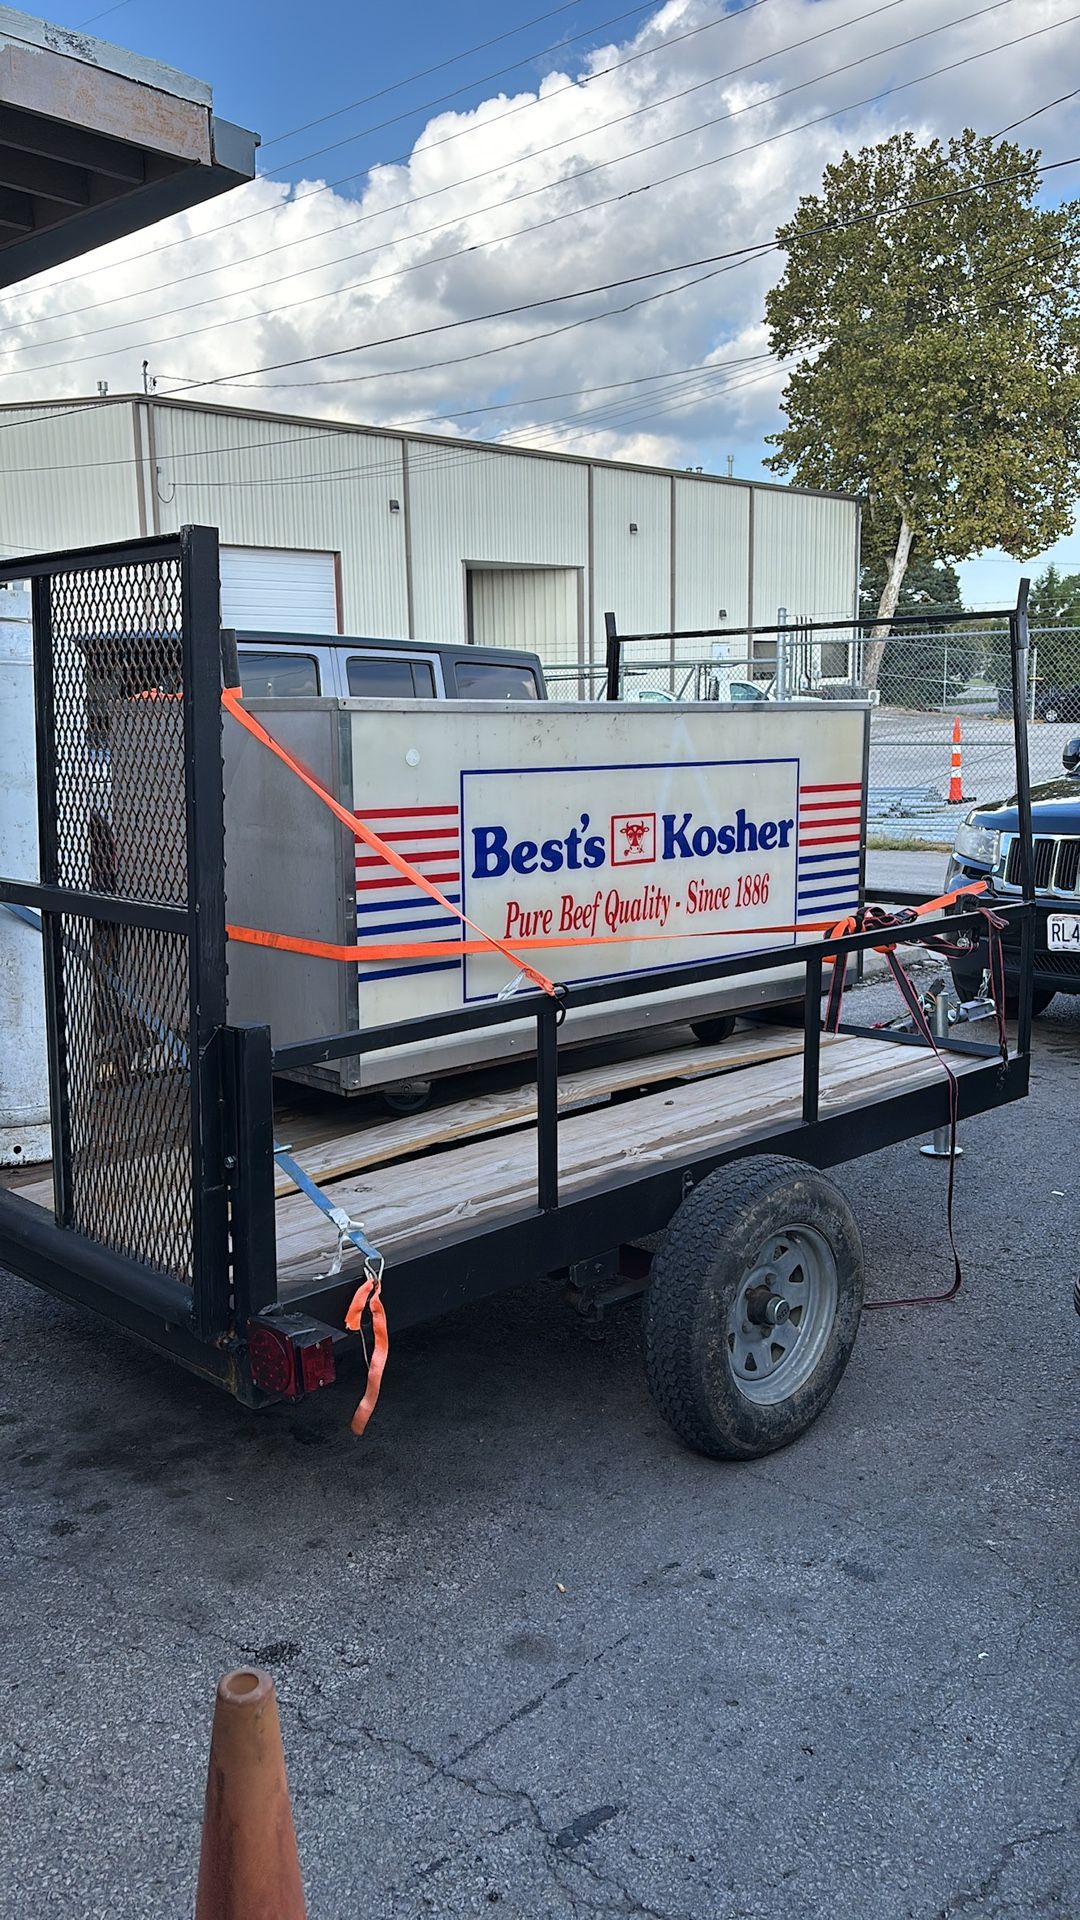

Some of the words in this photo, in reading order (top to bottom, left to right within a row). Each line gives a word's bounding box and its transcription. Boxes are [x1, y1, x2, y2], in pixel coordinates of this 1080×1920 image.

[472, 813, 606, 878] Best's
[662, 809, 794, 860] Kosher
[504, 901, 553, 939] Pure
[559, 890, 602, 936] Beef
[605, 885, 670, 933] Quality
[686, 879, 730, 914] Since
[734, 873, 770, 907] 1886
